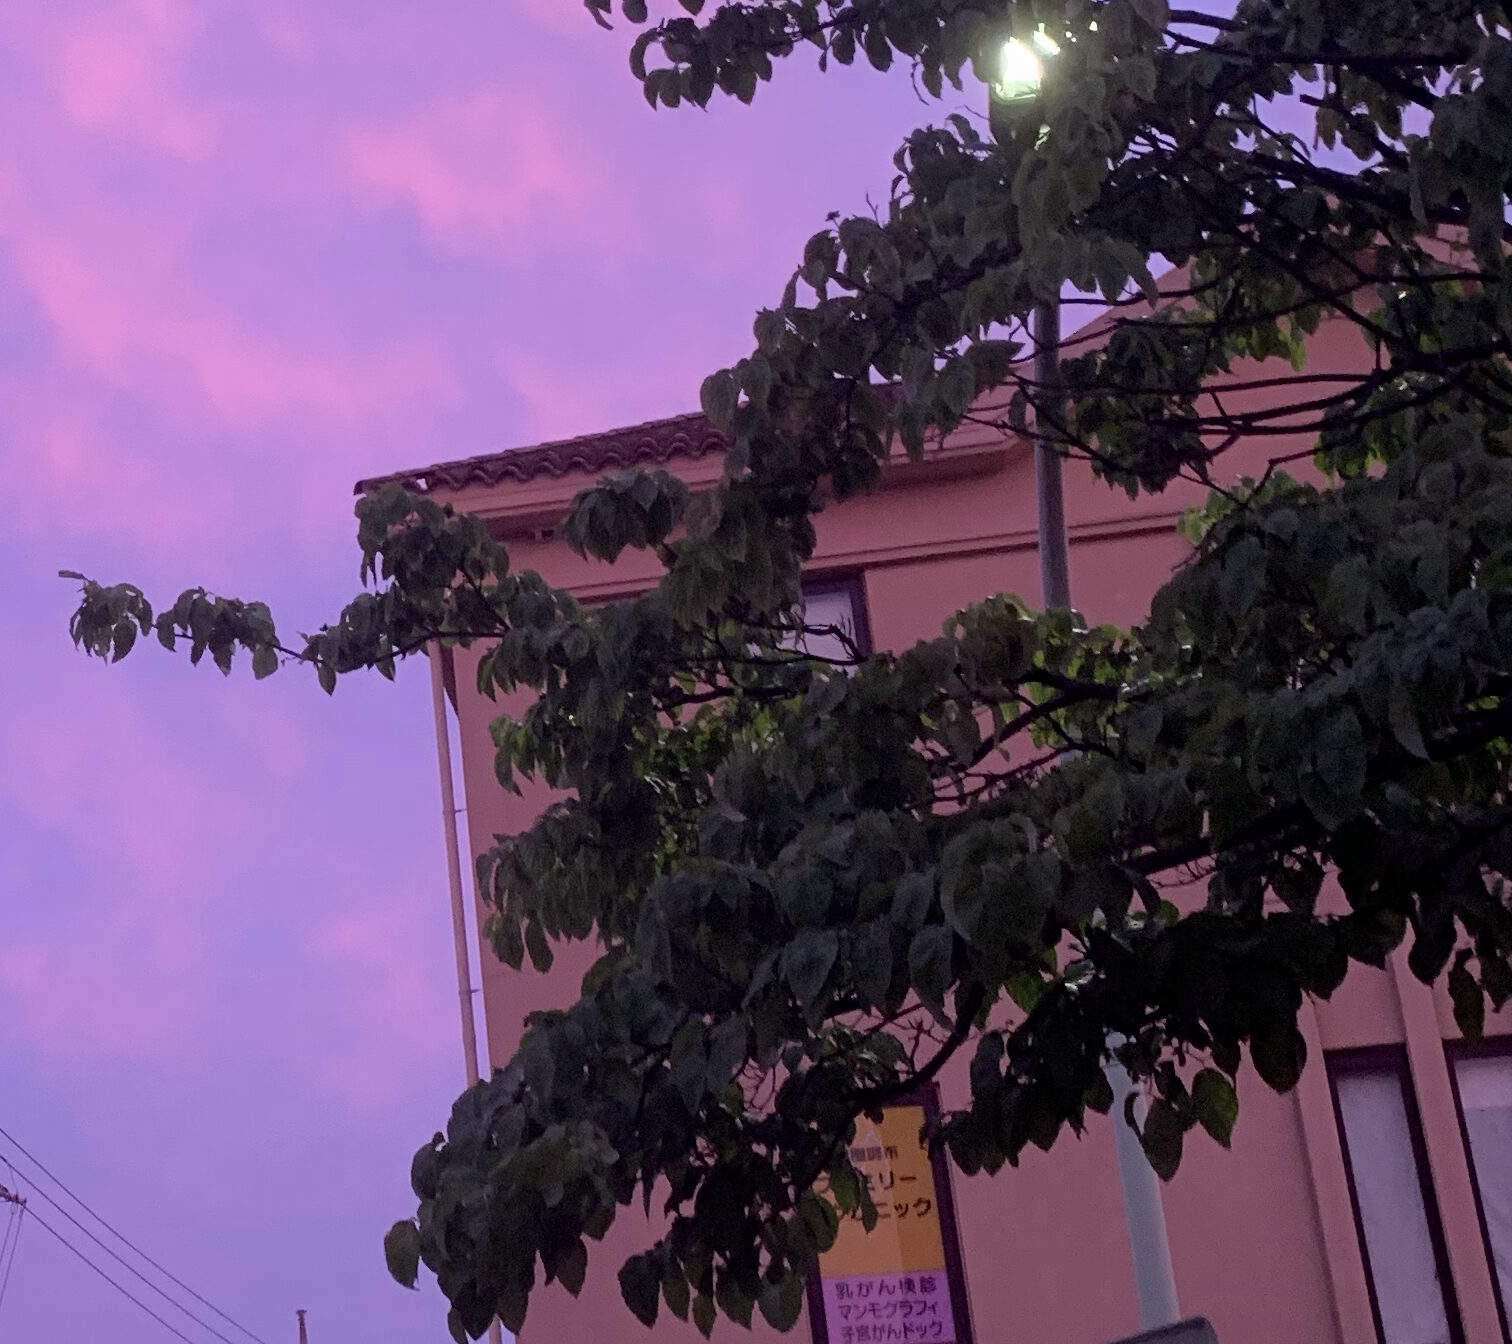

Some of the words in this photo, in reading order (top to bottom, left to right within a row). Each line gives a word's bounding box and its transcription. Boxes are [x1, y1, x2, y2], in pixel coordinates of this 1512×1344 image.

[838, 1300, 938, 1320] マンモグラフィ
